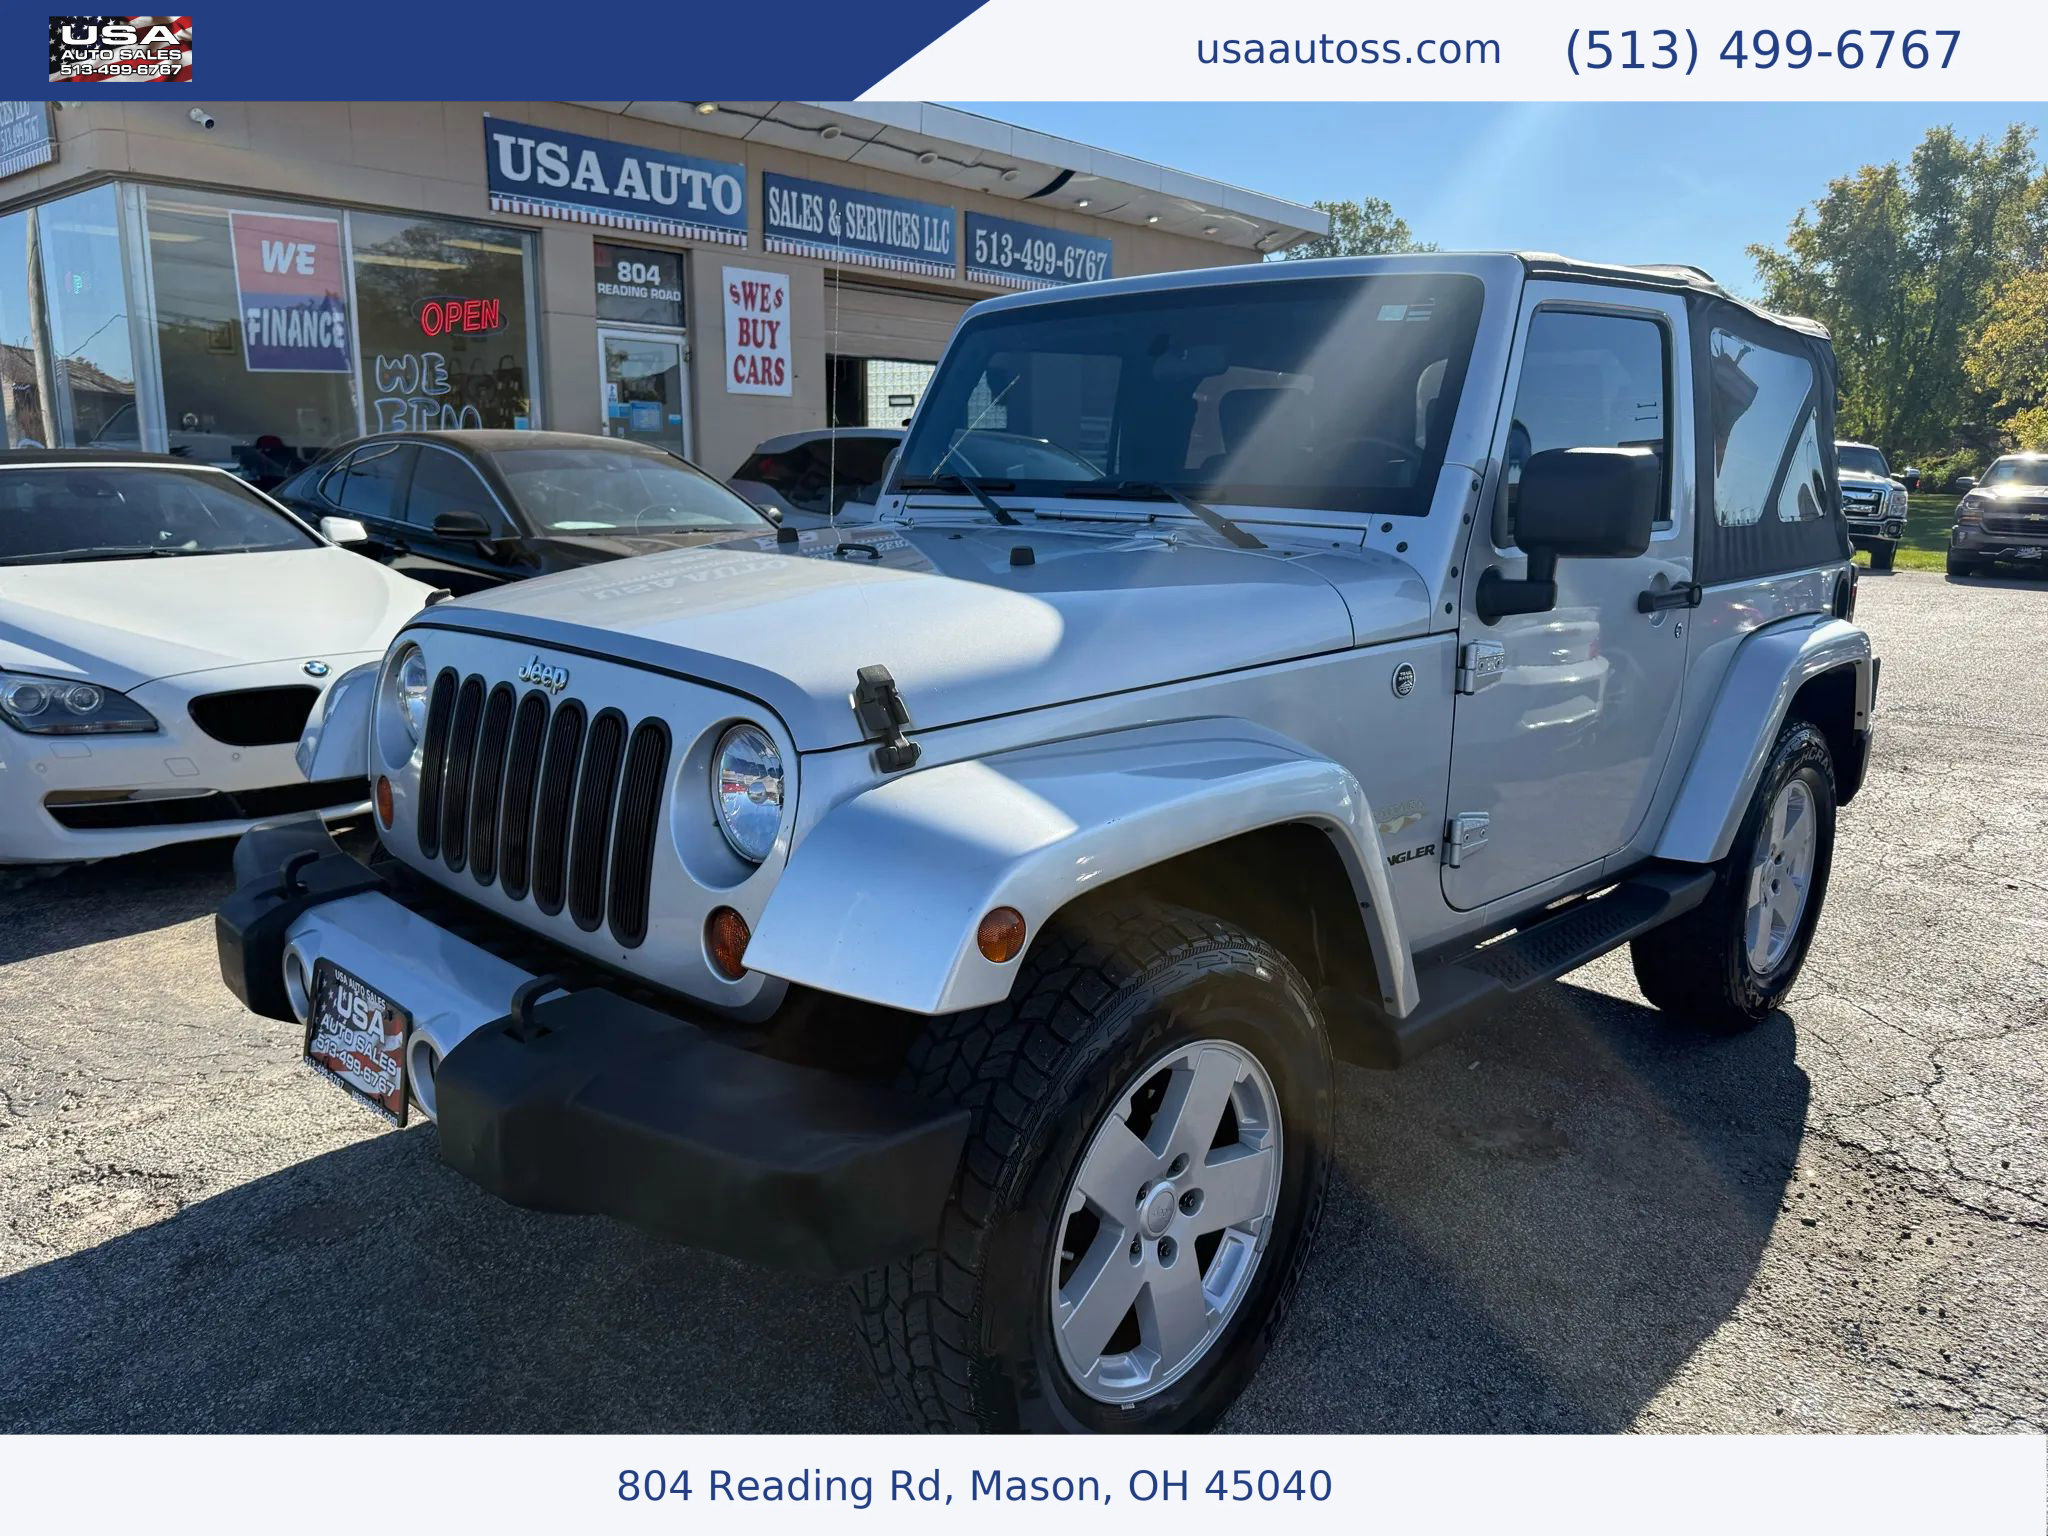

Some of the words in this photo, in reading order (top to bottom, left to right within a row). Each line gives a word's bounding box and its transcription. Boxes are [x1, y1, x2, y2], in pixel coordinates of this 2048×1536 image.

[493, 133, 609, 195] USA
[614, 157, 742, 216] AUTO
[769, 186, 824, 234] SALES
[828, 198, 841, 236] &
[845, 201, 920, 250] SERVICES
[924, 216, 950, 255] LLC
[261, 240, 316, 275] WE
[617, 261, 661, 285] 804
[975, 229, 1108, 281] 513-499-6767
[597, 283, 648, 299] READING
[650, 288, 682, 302] ROAD
[246, 307, 346, 349] FINANCE
[420, 298, 500, 337] OPEN
[738, 317, 781, 350] BUY
[376, 352, 451, 395] WE
[733, 354, 785, 386] CARS
[518, 655, 569, 695] Jeep
[1387, 844, 1435, 866] NGLER
[334, 968, 349, 986] USA
[348, 978, 366, 997] AUTO
[366, 988, 386, 1011] SALES
[336, 985, 385, 1046] USA
[320, 1012, 354, 1046] AUTO
[355, 1035, 398, 1076] SALES
